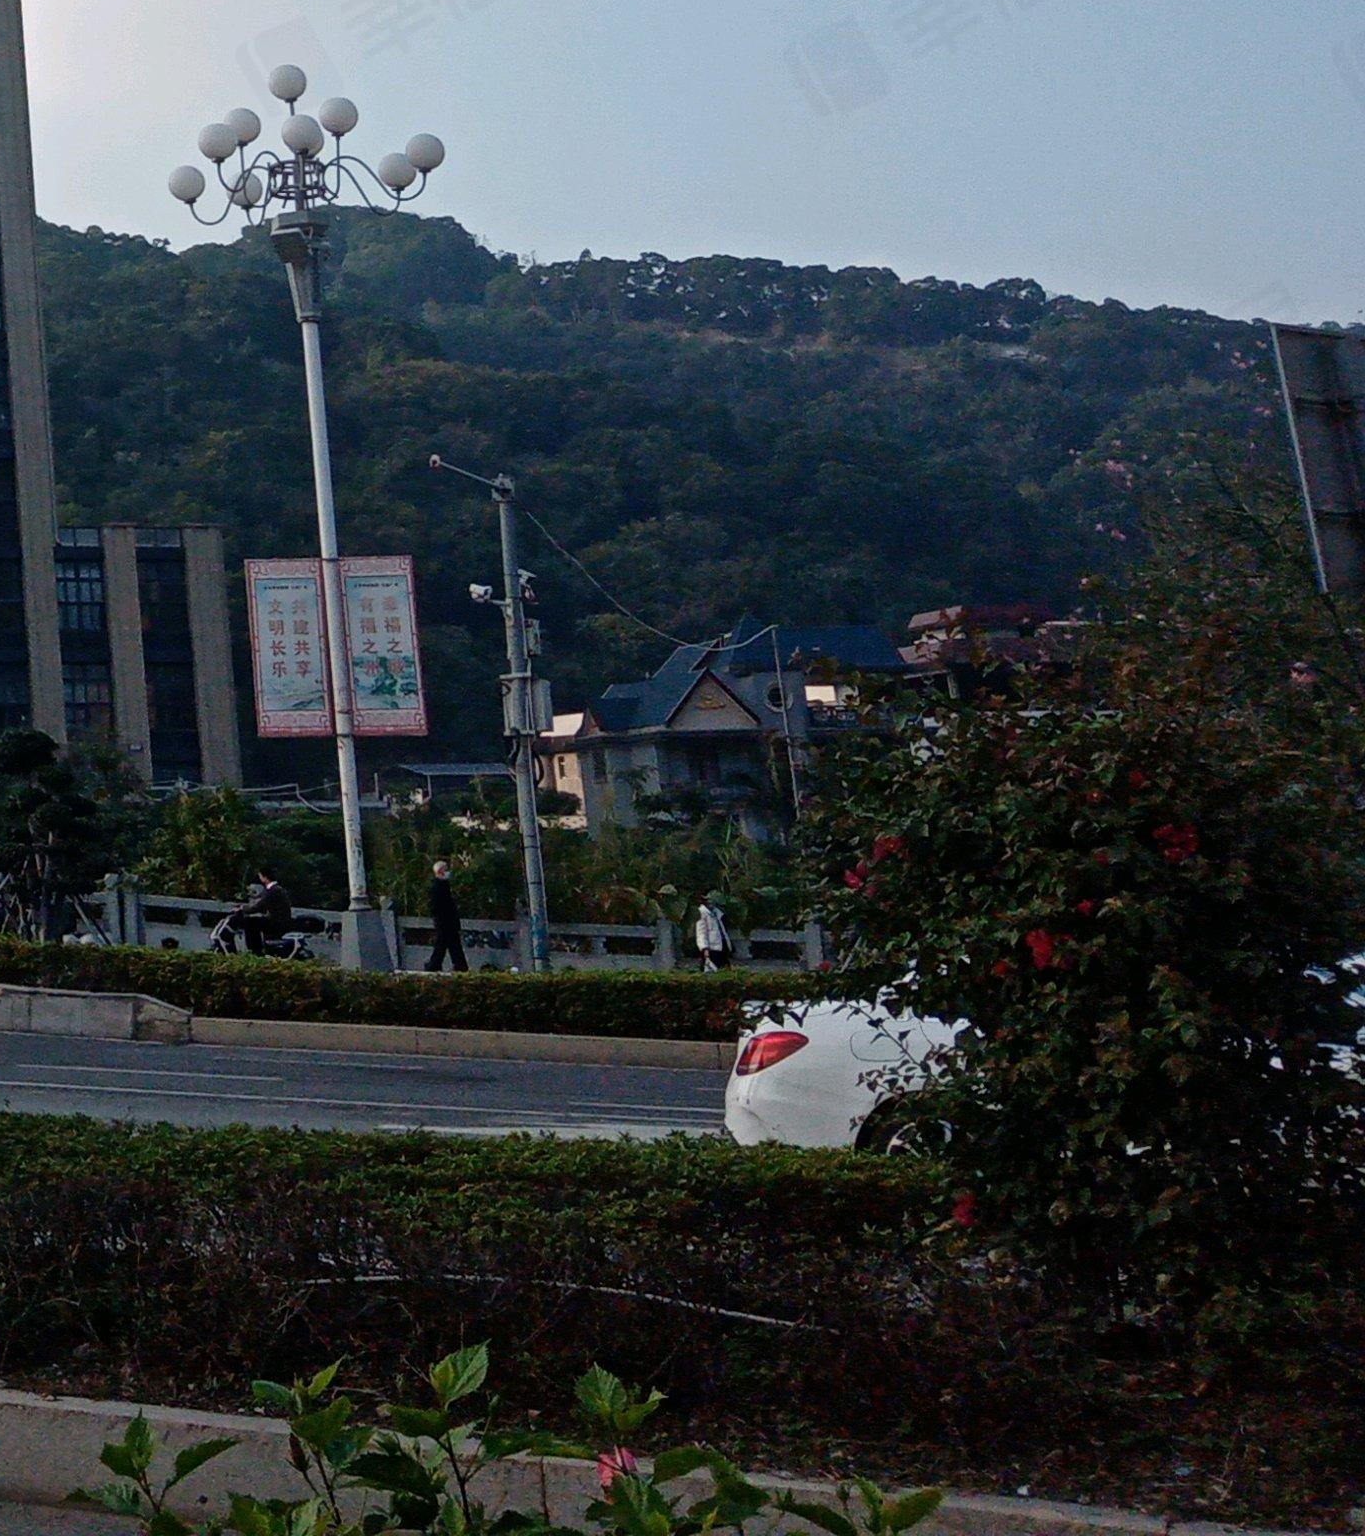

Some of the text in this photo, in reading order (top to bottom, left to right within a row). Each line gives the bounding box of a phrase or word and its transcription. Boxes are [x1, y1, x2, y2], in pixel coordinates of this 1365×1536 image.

[269, 598, 287, 678] 文明长乐
[292, 598, 311, 678] 共建共享
